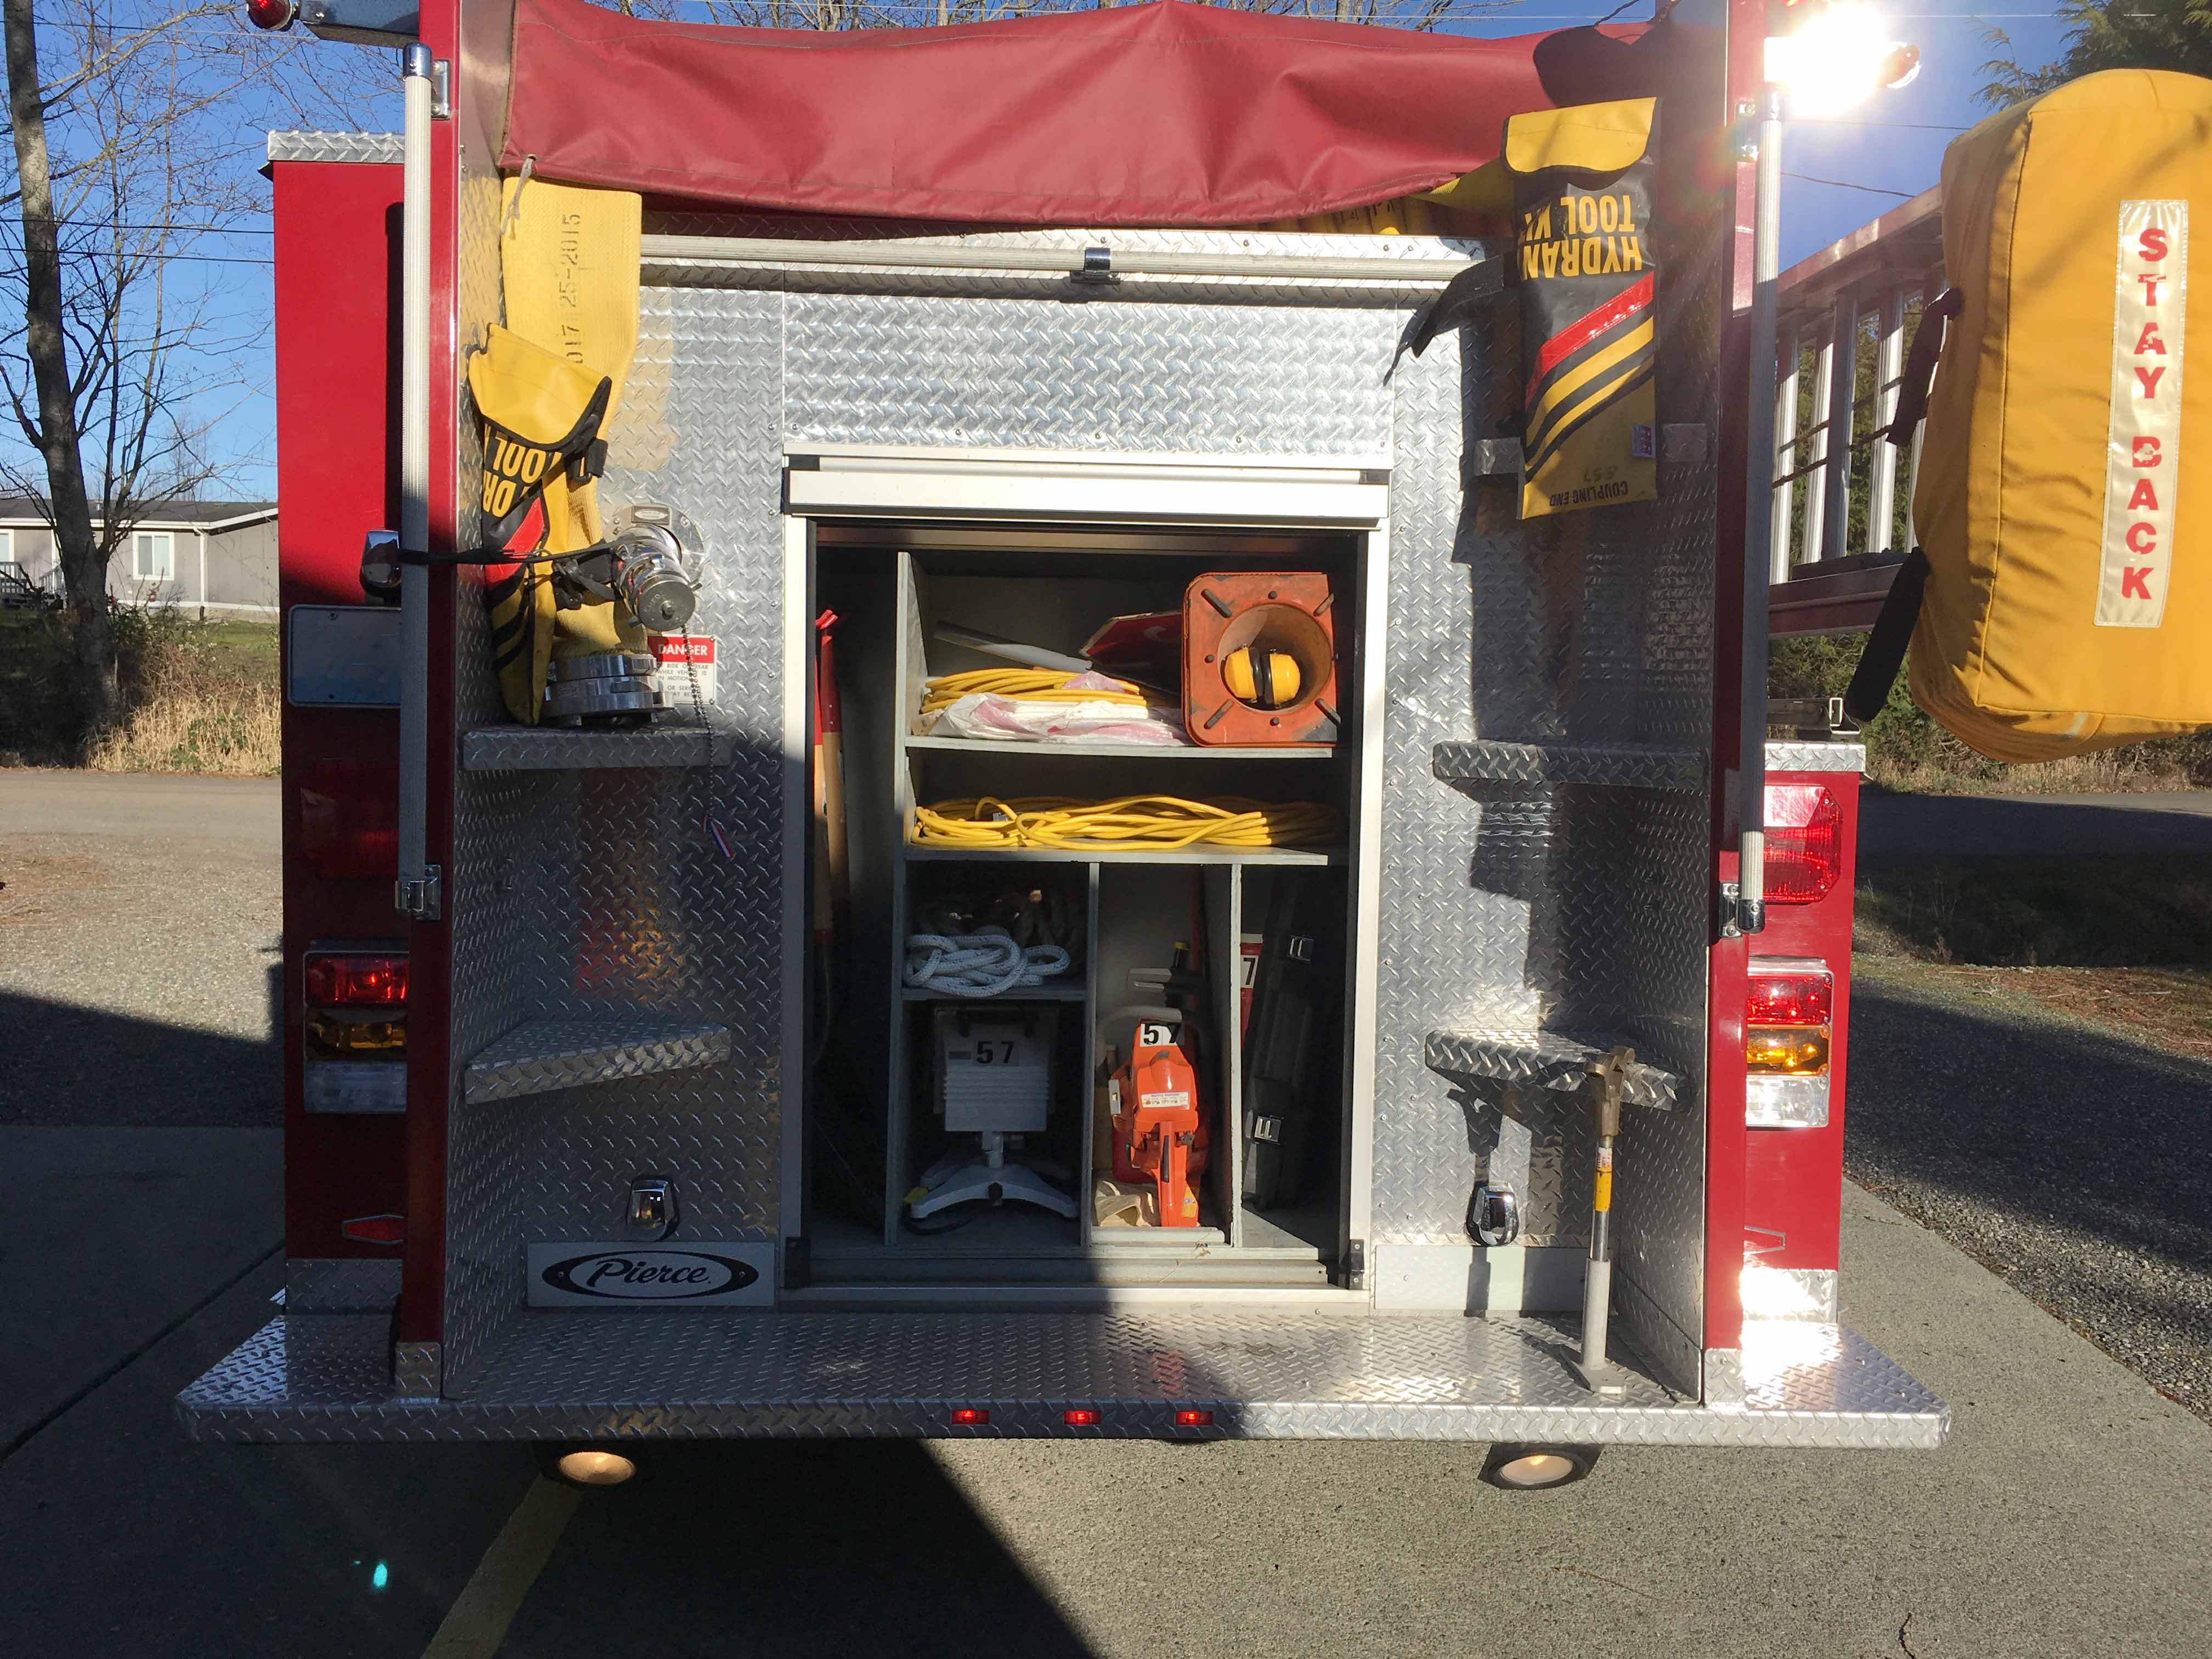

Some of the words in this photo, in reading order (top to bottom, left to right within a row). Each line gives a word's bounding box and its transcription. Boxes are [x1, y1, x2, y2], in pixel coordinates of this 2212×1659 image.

[1561, 195, 1635, 235] TOOL
[2134, 228, 2168, 399] STAY
[1549, 491, 1570, 507] END
[1573, 480, 1628, 504] COUPLING
[2121, 436, 2162, 600] BACK
[1143, 1023, 1180, 1045] 57
[977, 1041, 1015, 1064] 57
[586, 1259, 709, 1287] Pierce
